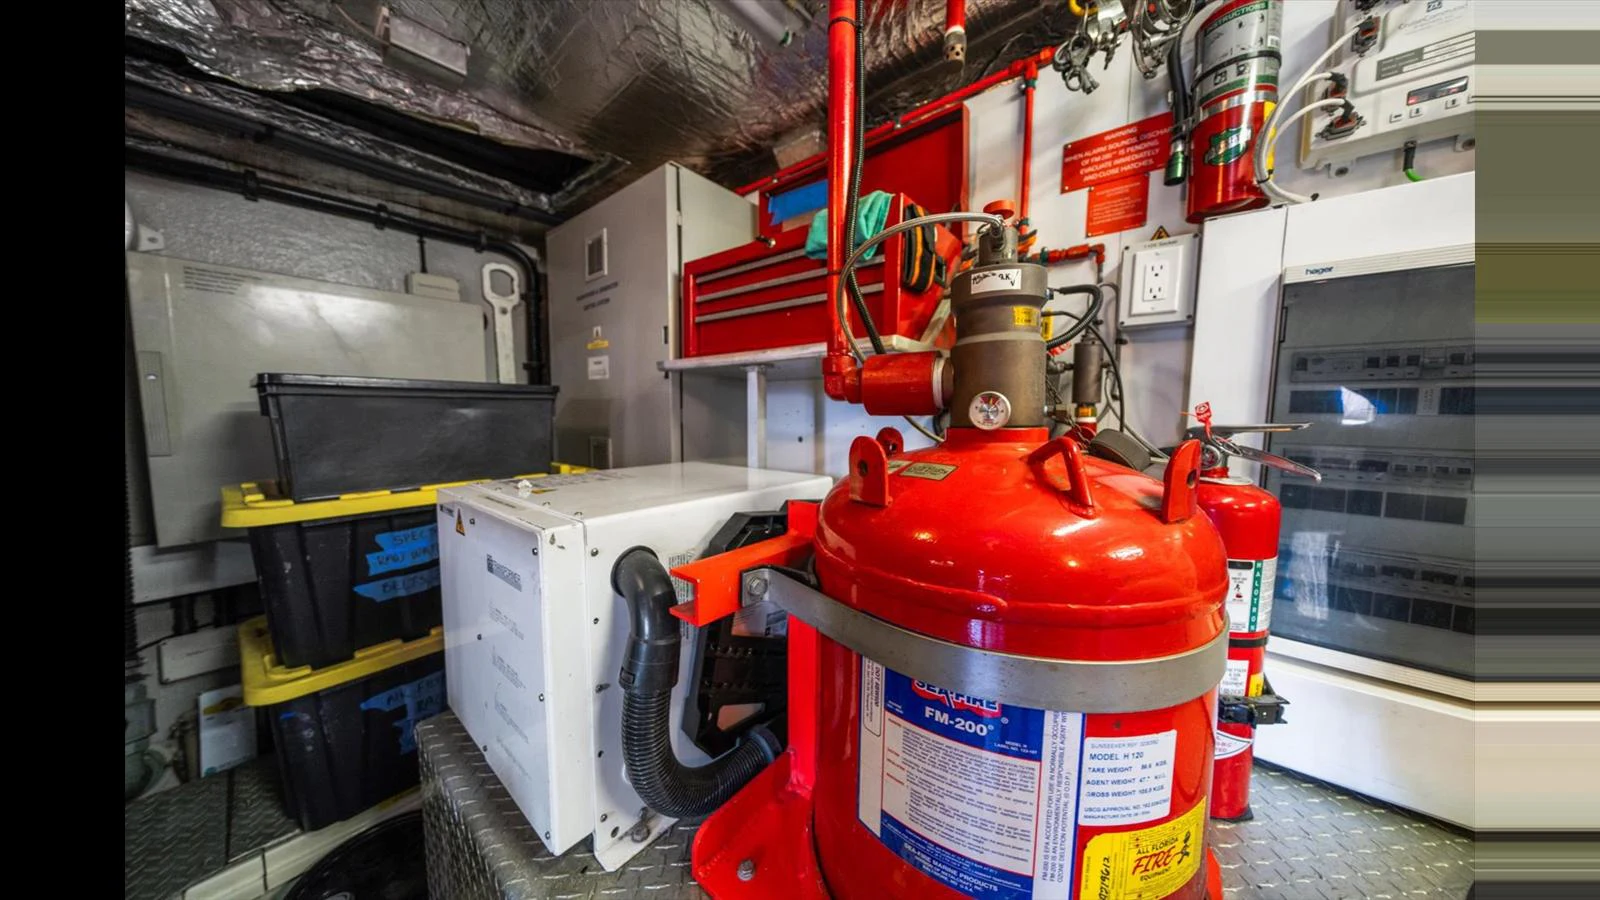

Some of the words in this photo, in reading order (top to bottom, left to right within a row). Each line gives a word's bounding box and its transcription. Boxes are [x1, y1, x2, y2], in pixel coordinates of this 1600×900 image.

[1306, 266, 1334, 276] hager
[1048, 741, 1057, 773] NORMALLY
[1056, 746, 1064, 787] RESPONSIBLE
[1043, 808, 1054, 840] ACCEPTED
[1051, 788, 1061, 844] ENVIRONMENTALLY
[1050, 845, 1057, 854] AN
[1152, 837, 1178, 852] FLORIDA
[932, 859, 959, 874] MARINE
[960, 872, 998, 892] PRODUCTS
[1132, 845, 1176, 876] FIRE
[1140, 866, 1172, 882] EQUIPMENT
